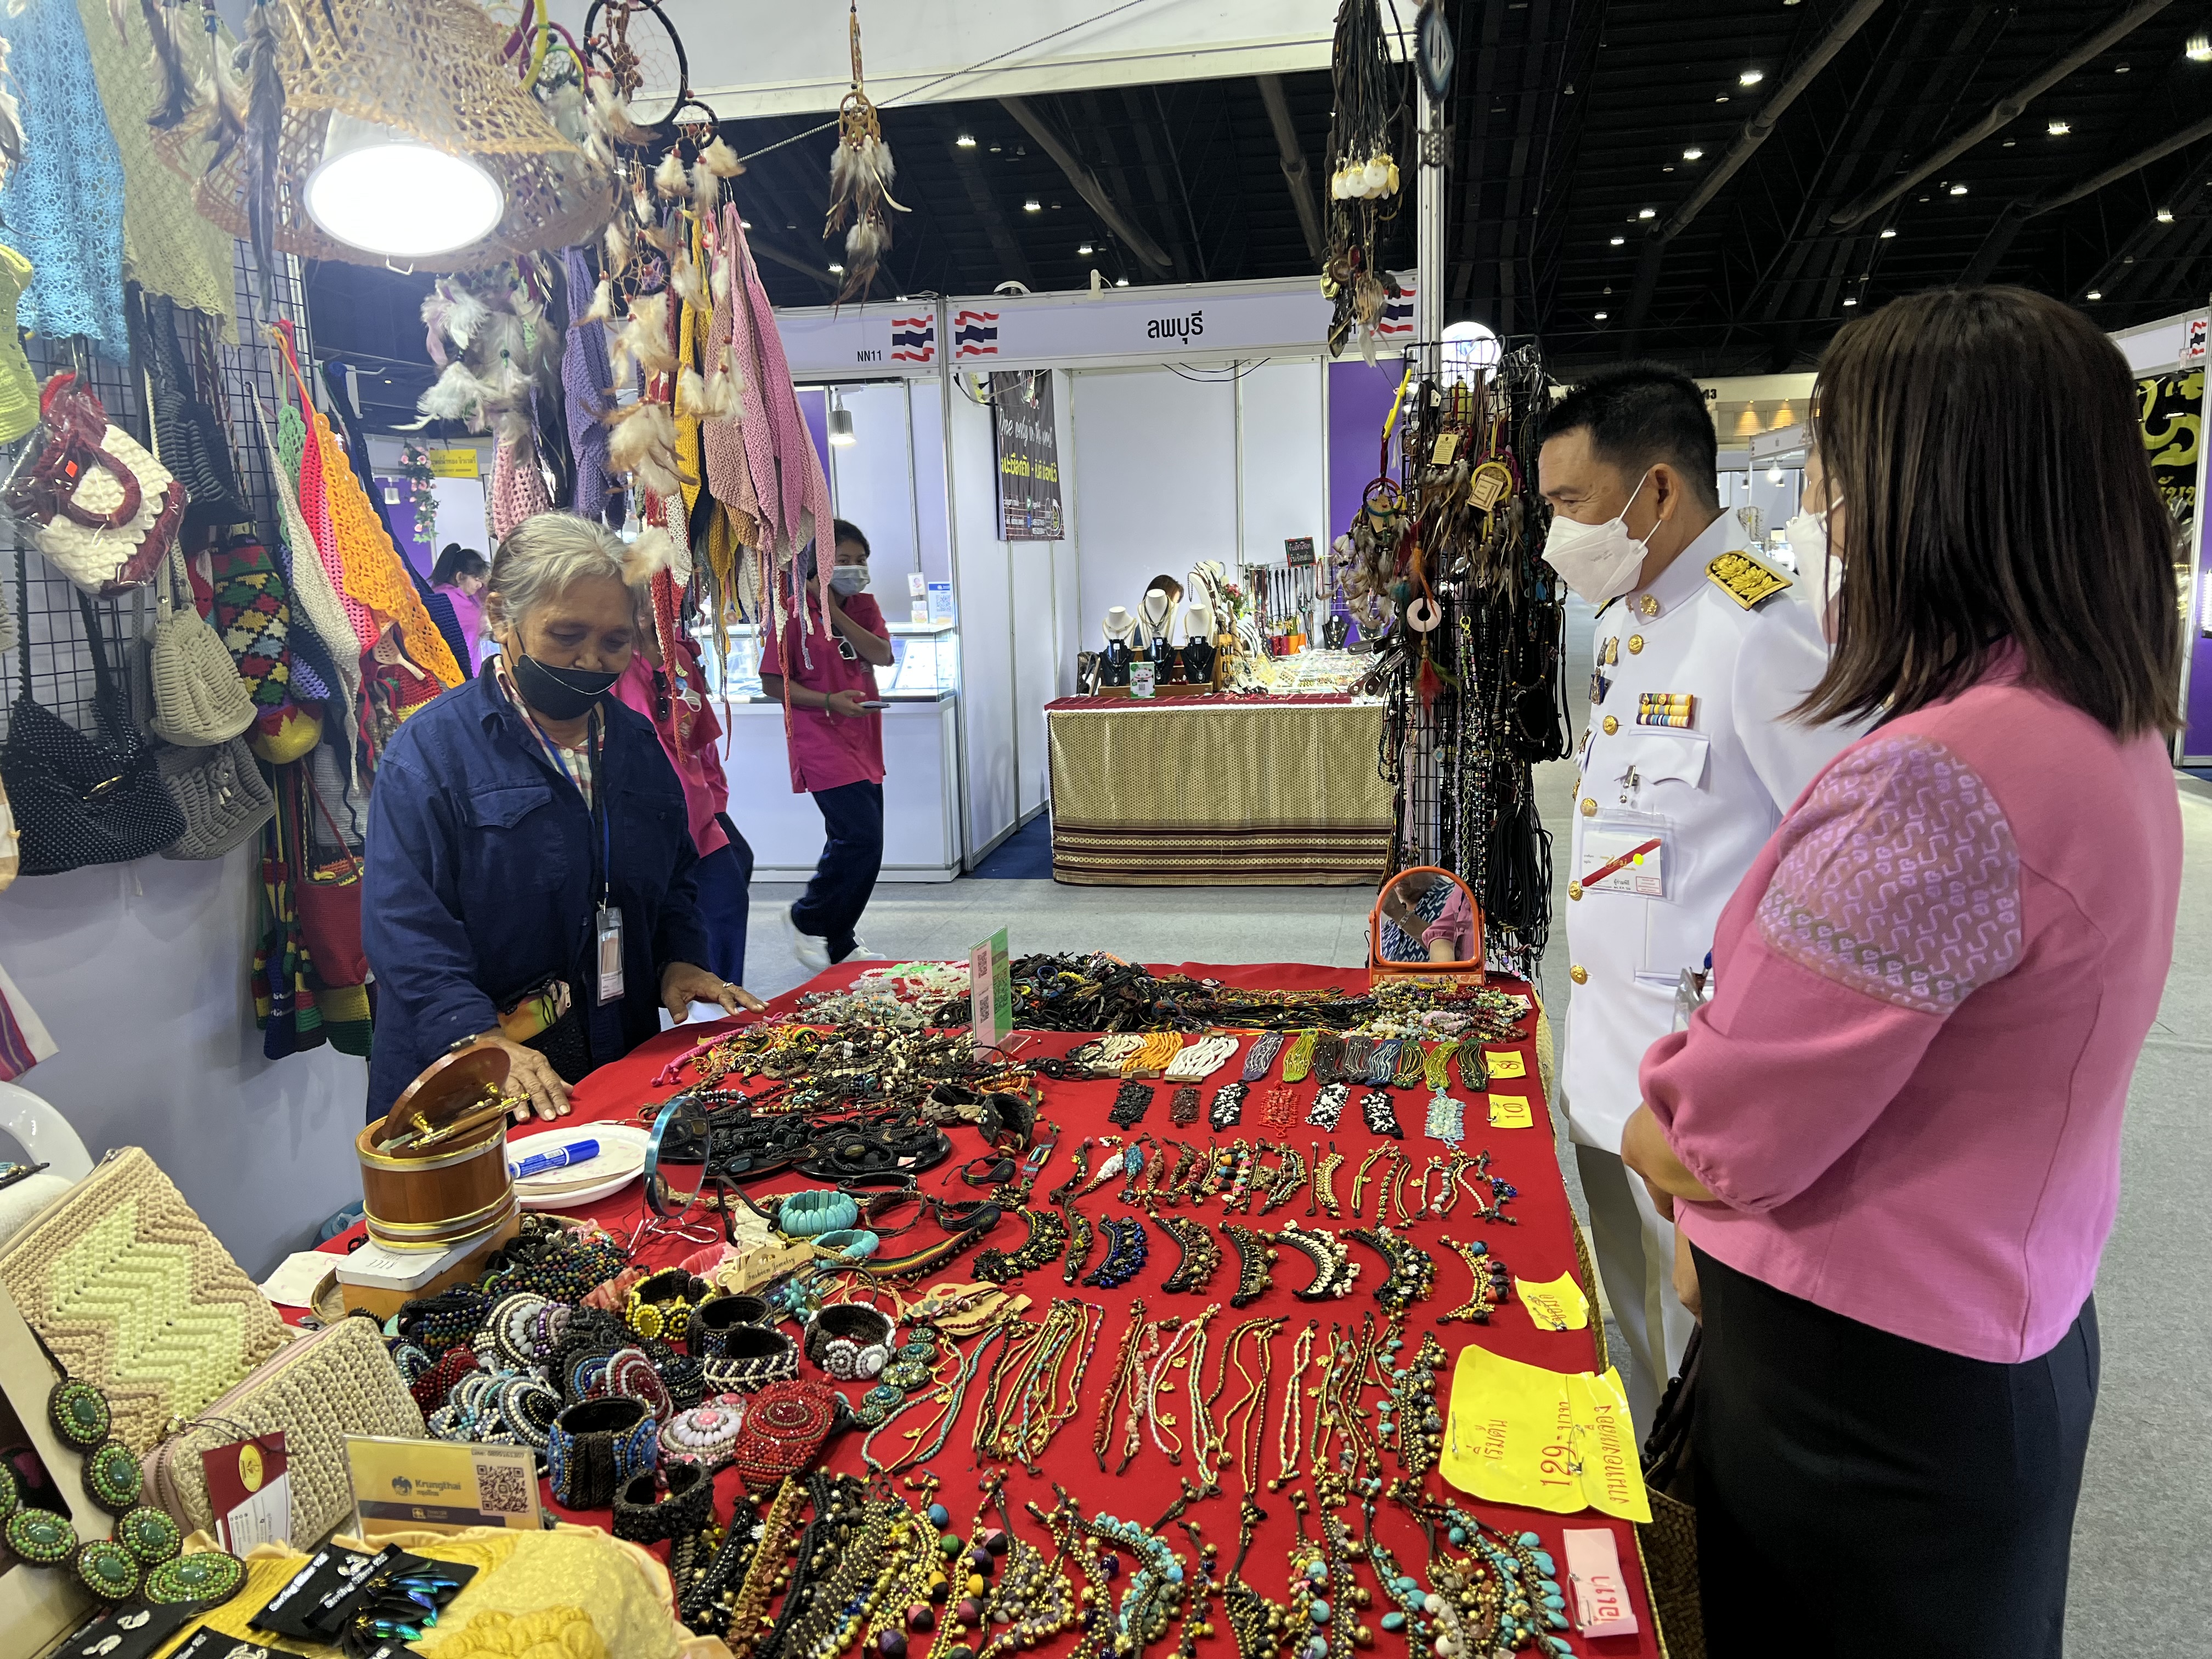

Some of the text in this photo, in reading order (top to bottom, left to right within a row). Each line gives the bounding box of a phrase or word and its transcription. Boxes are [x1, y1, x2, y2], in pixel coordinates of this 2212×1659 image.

[1147, 310, 1204, 345] ลพบุรี
[857, 350, 882, 363] NN11
[746, 1257, 794, 1281] Fashion Jewelry
[1466, 1420, 1508, 1460] เริ่มต้น
[1585, 1406, 1629, 1502] งานทองเหลือง
[415, 1480, 461, 1491] Krungthai
[372, 1552, 390, 1567] 925
